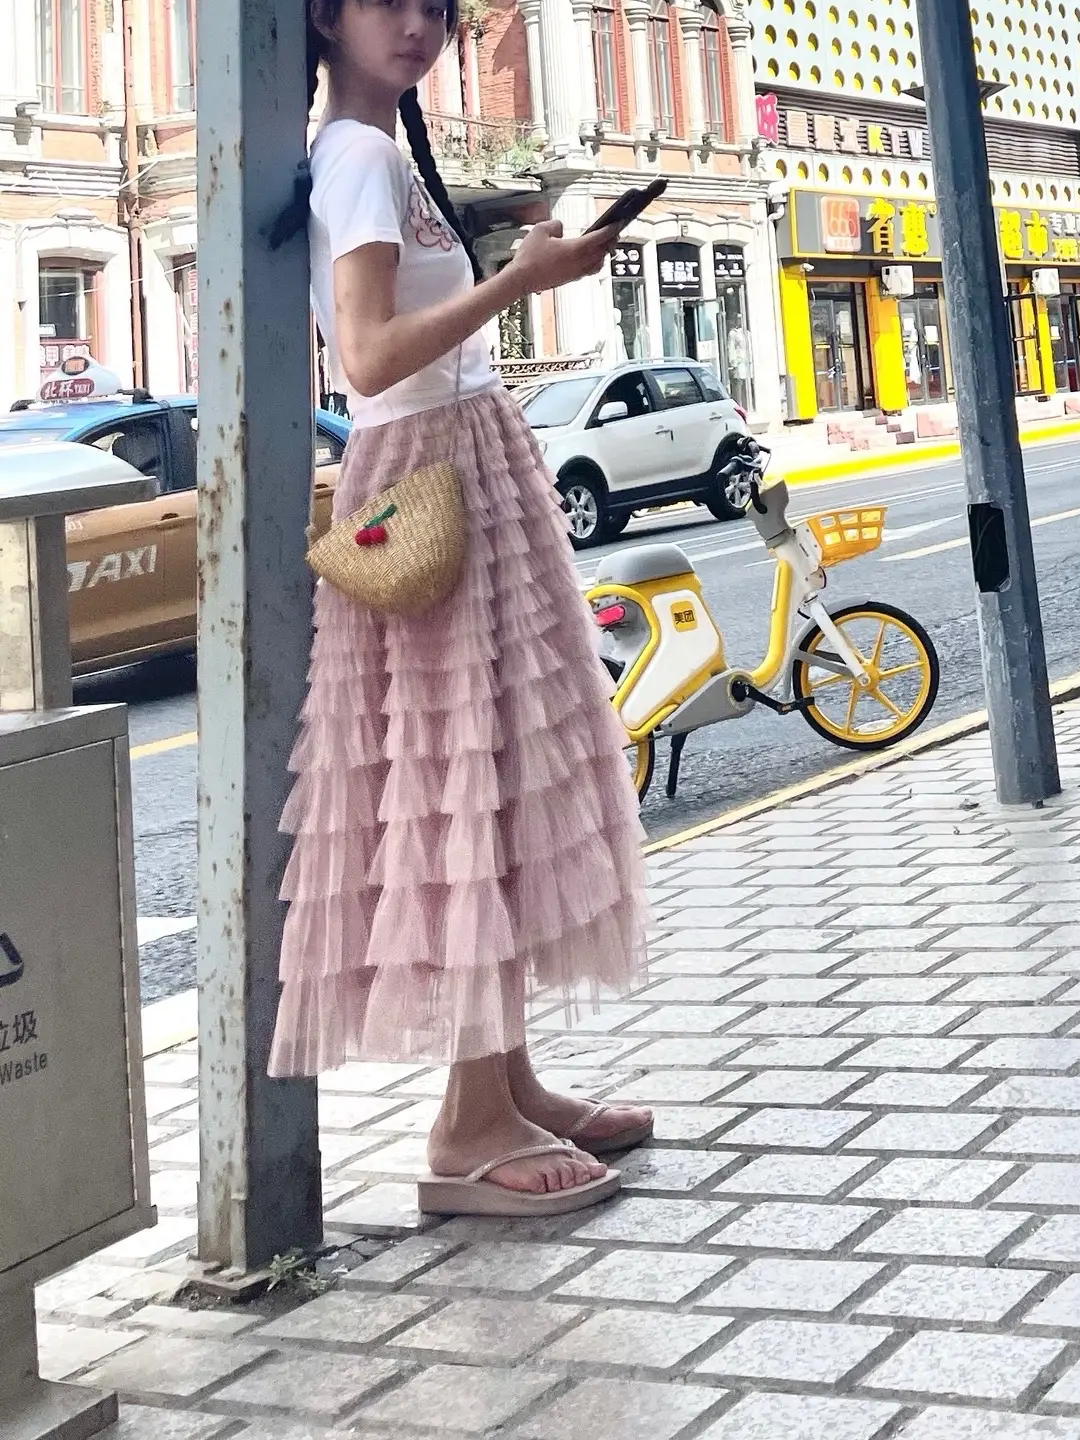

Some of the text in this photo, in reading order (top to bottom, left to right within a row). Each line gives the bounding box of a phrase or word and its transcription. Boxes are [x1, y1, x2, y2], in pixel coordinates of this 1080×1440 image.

[66, 544, 157, 593] TAXI
[673, 609, 695, 625] 美团
[0, 1050, 48, 1086] Waste
